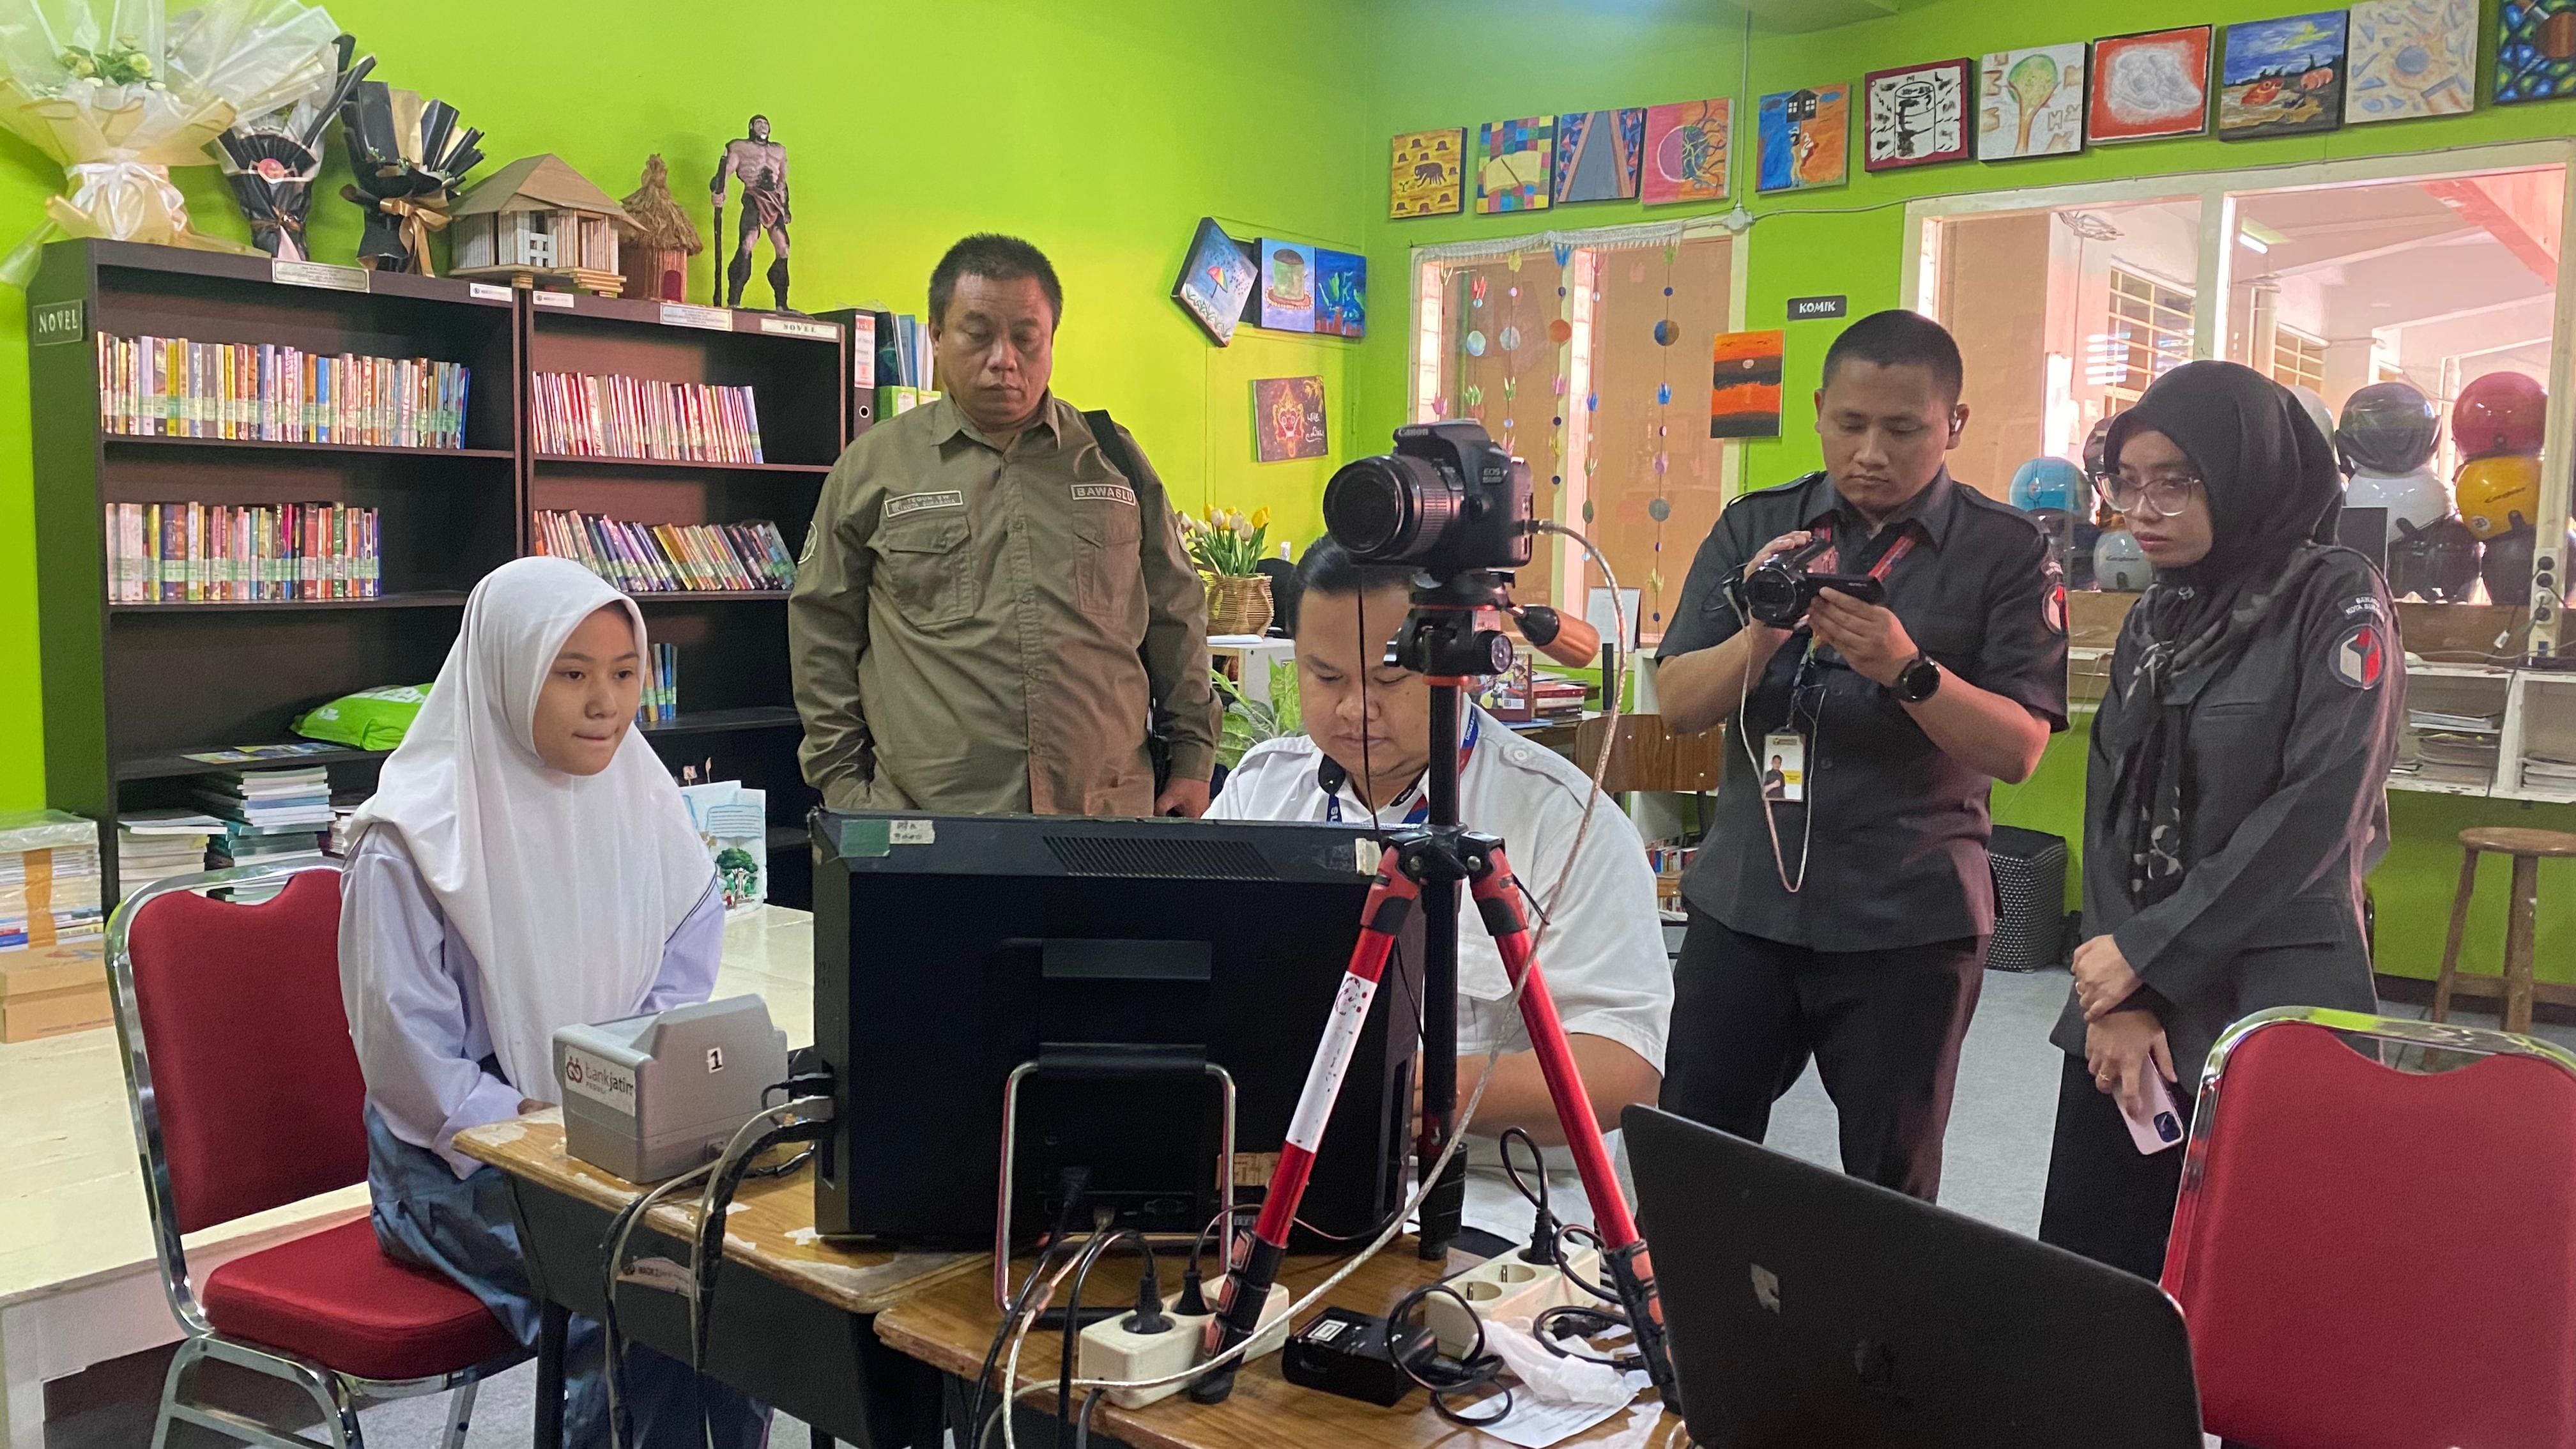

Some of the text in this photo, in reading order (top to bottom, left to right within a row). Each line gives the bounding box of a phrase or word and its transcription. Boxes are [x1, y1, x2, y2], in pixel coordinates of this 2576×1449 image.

[1798, 300, 1836, 314] KOMIK
[38, 309, 79, 334] NOVEL
[783, 323, 817, 334] NOVEL
[1397, 427, 1429, 438] Canon
[1483, 467, 1501, 476] EOS
[1076, 486, 1133, 502] BAWASLU
[2345, 604, 2363, 615] KOTA
[710, 1050, 723, 1070] 1
